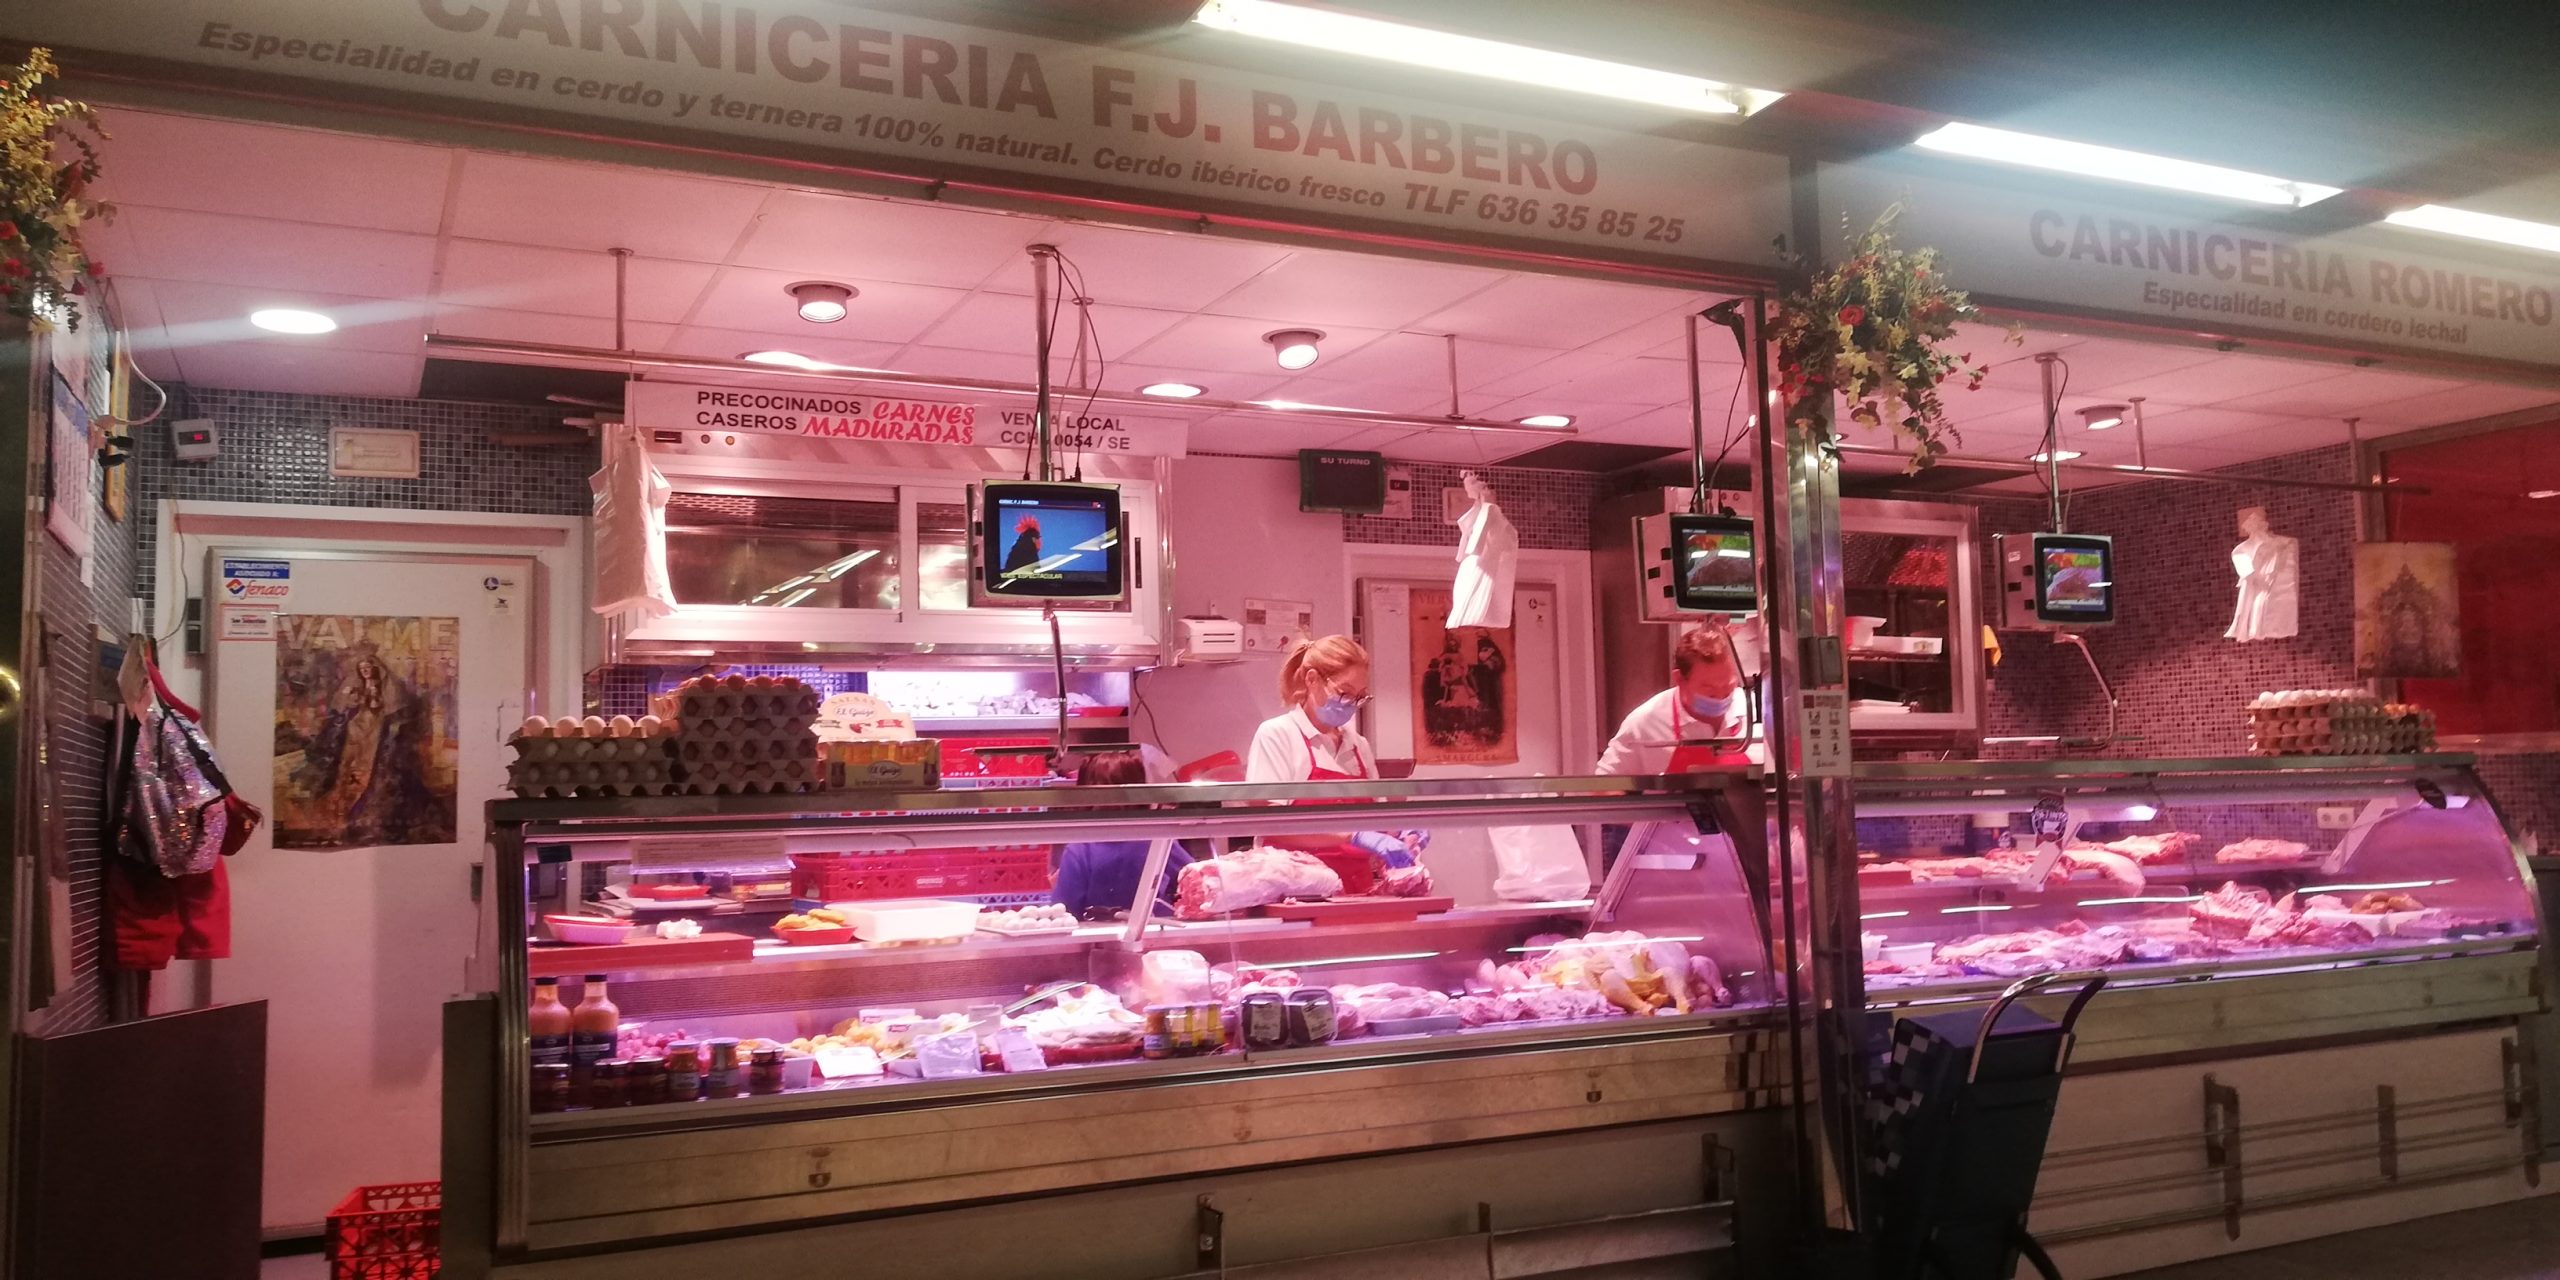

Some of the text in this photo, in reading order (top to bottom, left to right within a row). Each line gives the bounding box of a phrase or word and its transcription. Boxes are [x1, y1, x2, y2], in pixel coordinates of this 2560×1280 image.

[198, 21, 1684, 243] Especialidad en cerdo y ternera 100% natural. Cerdo ibérico fresco TLF 636 35 85 25
[1092, 65, 1221, 143] F.J.
[1253, 89, 1598, 195] BARBERO
[2029, 209, 2553, 326] CARNICERIA ROMERO
[2143, 281, 2468, 344] Especialidad en cordero lechal
[697, 391, 862, 415] PRECOCINADOS
[872, 400, 976, 426] CARNES
[696, 411, 797, 430] CASEROS
[801, 415, 975, 445] MADURADAS
[1001, 412, 1126, 432] VENA LOCAL
[1054, 434, 1093, 448] 0054
[1107, 437, 1130, 450] SE
[1337, 458, 1371, 466] TURNO
